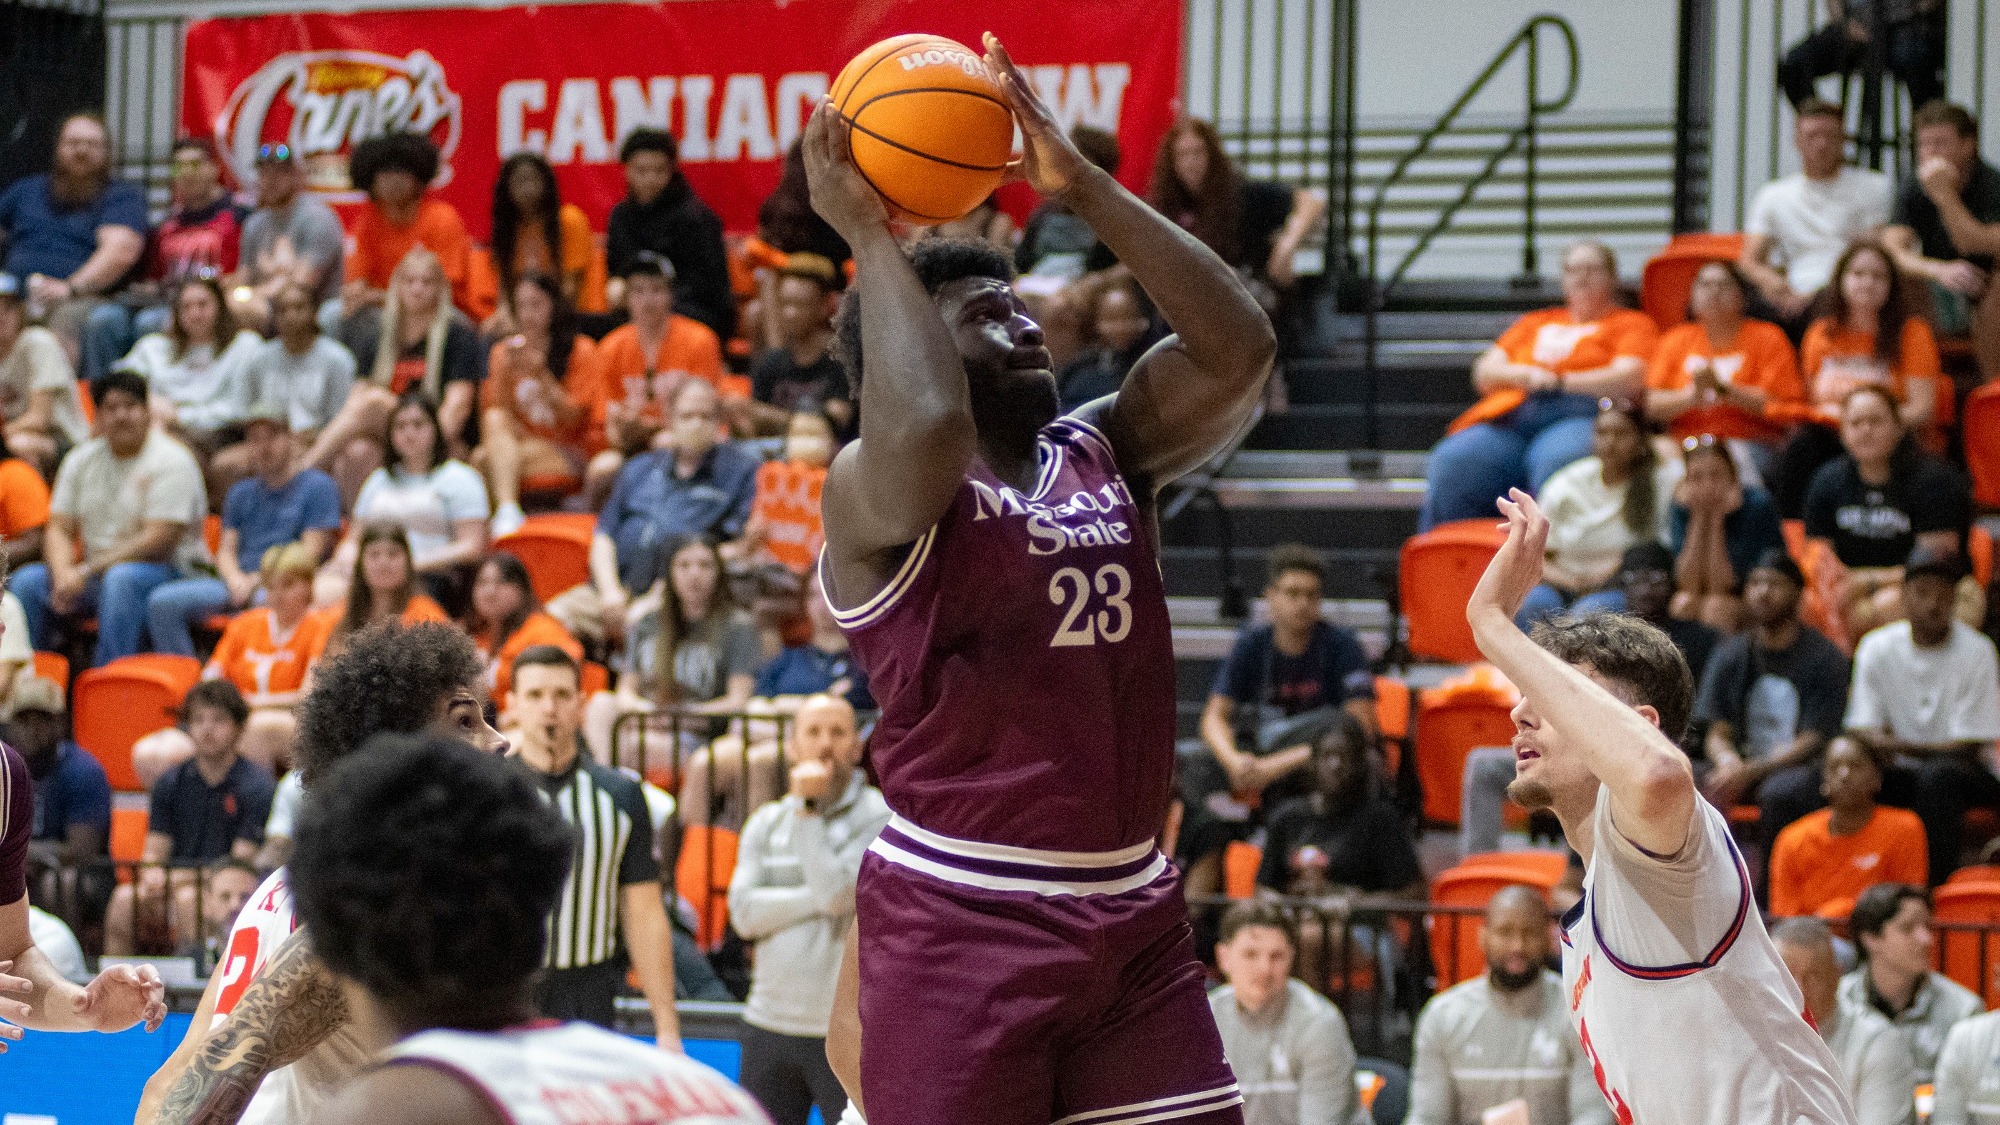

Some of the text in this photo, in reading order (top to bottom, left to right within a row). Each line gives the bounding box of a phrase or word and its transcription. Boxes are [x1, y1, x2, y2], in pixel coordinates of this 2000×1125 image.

[968, 474, 1134, 521] Mssouri
[1026, 514, 1132, 555] State
[1049, 563, 1133, 647] 23
